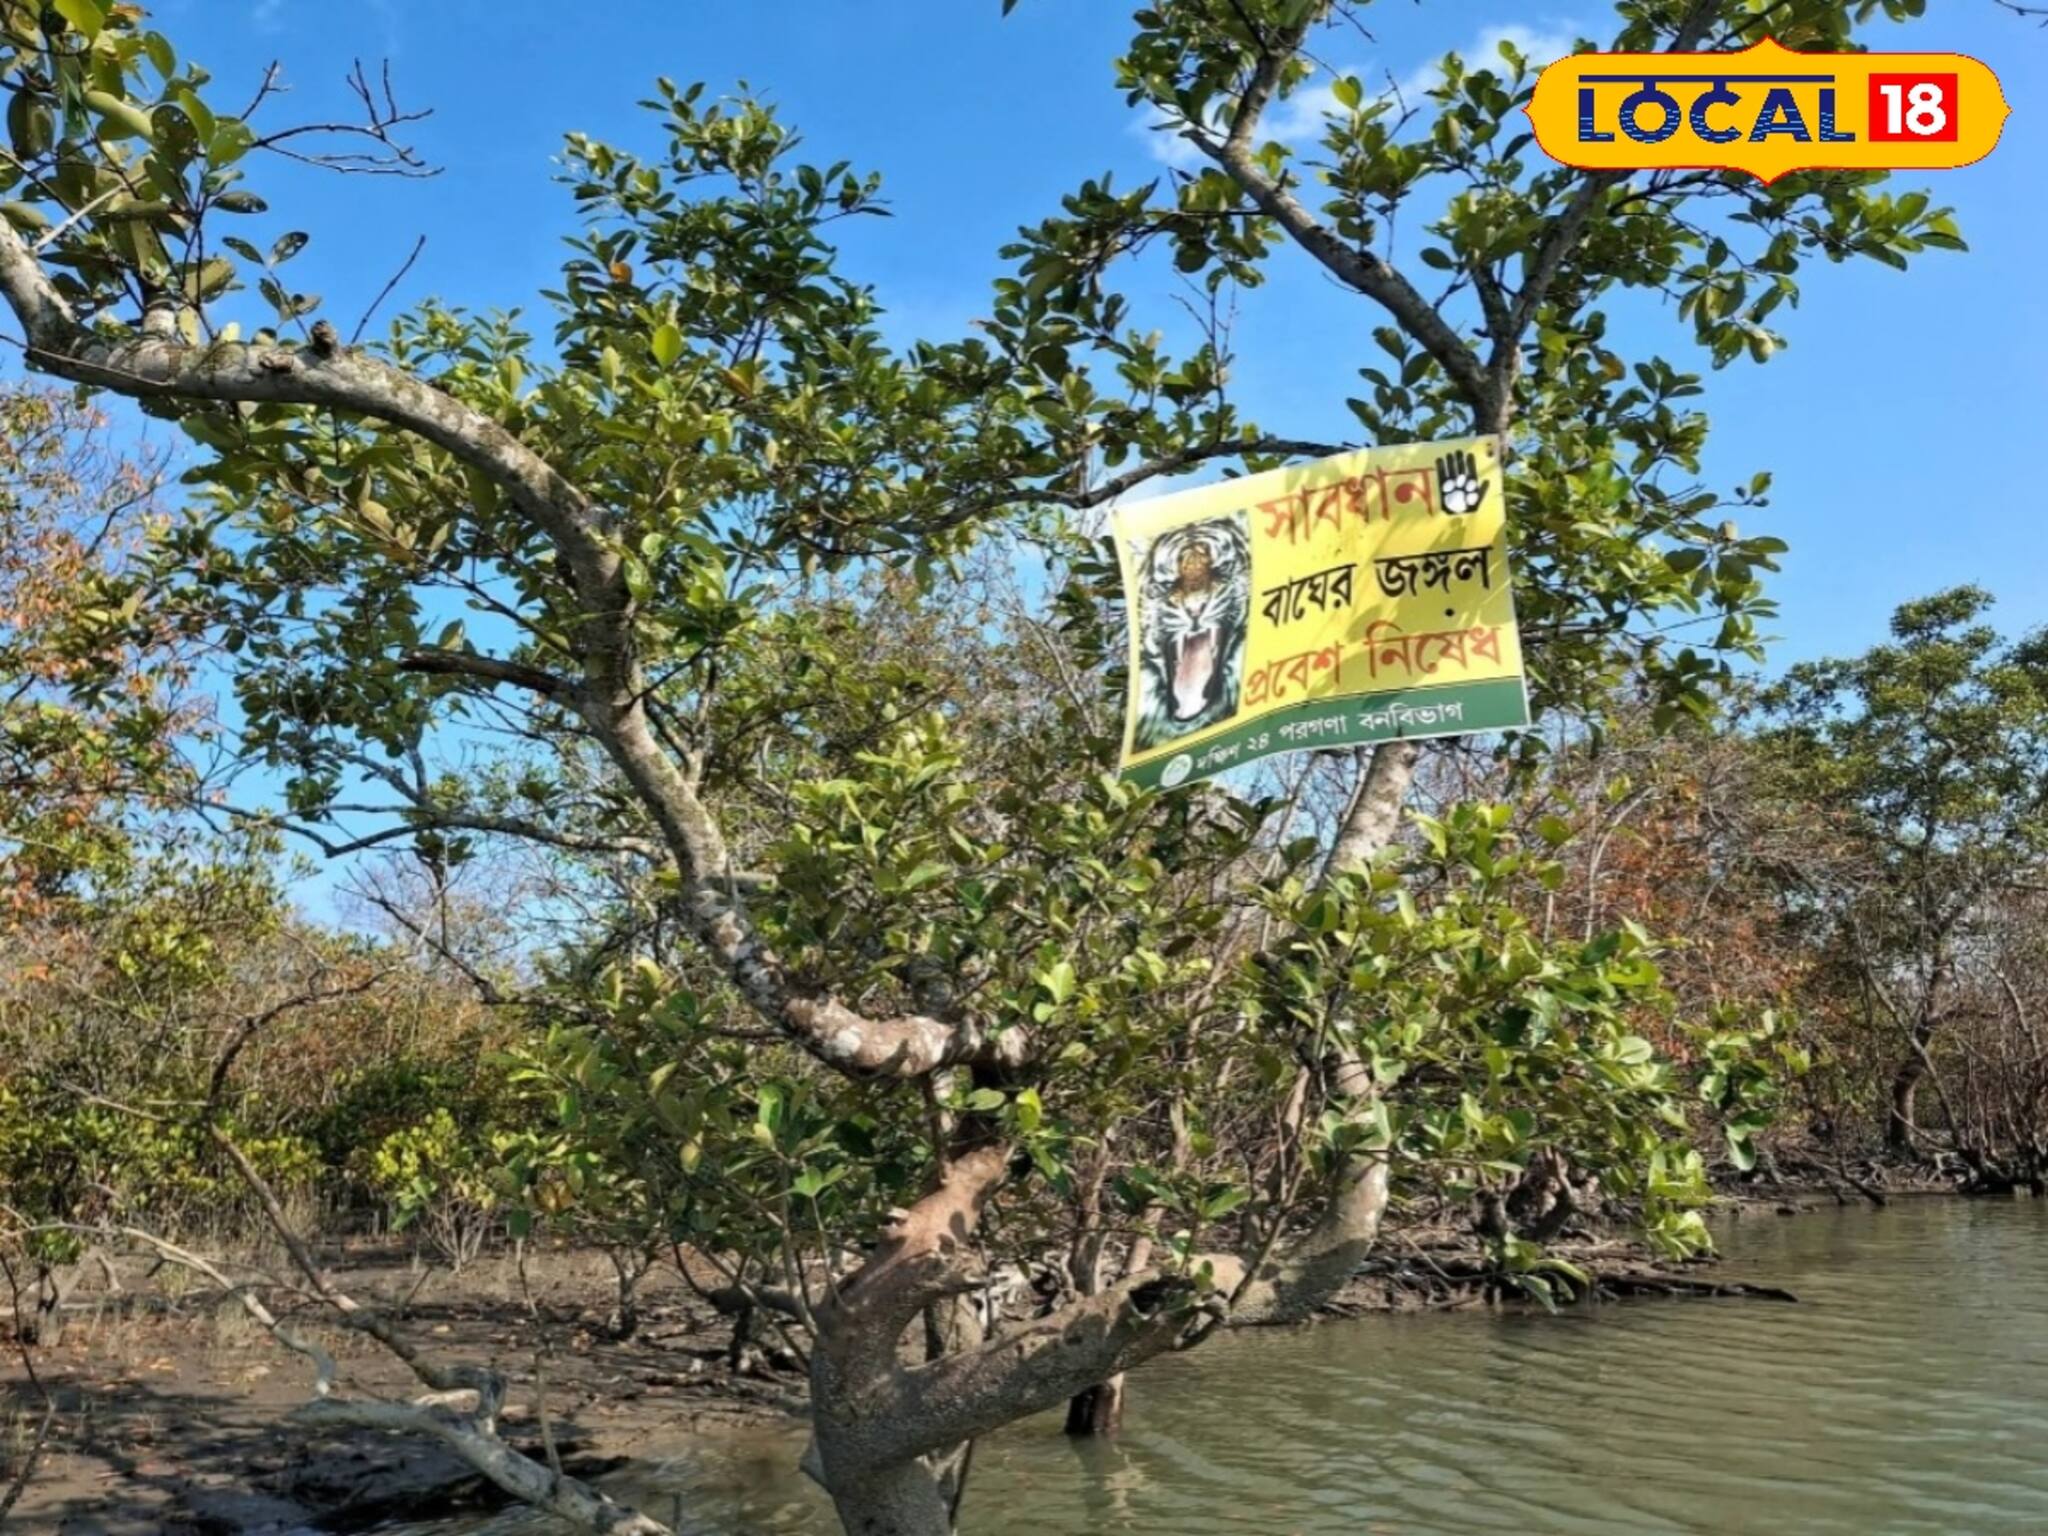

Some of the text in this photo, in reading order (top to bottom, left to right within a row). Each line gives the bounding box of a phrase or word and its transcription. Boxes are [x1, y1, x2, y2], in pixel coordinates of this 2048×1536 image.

[1254, 465, 1436, 546] সাবধান
[1262, 545, 1494, 628] বাঘের জঙ্গল
[1244, 619, 1503, 707] প্রবেশ নিষেধ
[1247, 733, 1271, 751] ২৪
[1357, 701, 1465, 732] বনবিভাগ
